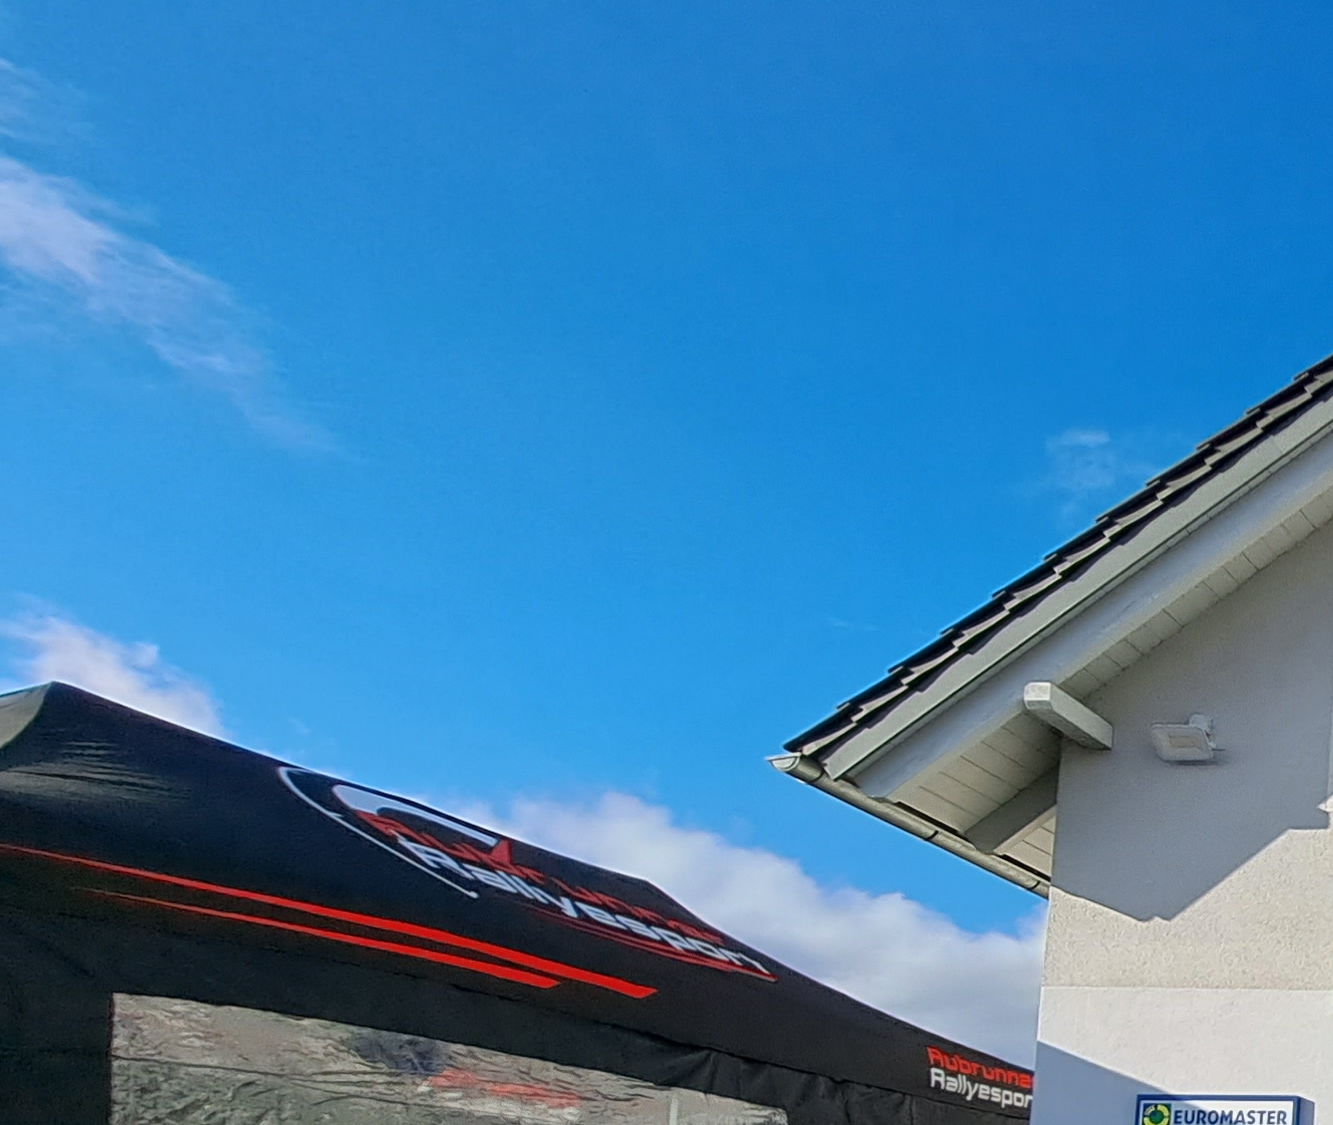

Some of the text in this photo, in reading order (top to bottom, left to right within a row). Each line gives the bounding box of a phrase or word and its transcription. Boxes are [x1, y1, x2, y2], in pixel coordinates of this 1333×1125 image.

[391, 830, 772, 974] Rallyesport
[927, 1045, 1034, 1089] Aubrunne
[930, 1067, 1033, 1109] Rallyespor
[1173, 1109, 1288, 1125] EUROMASTER
